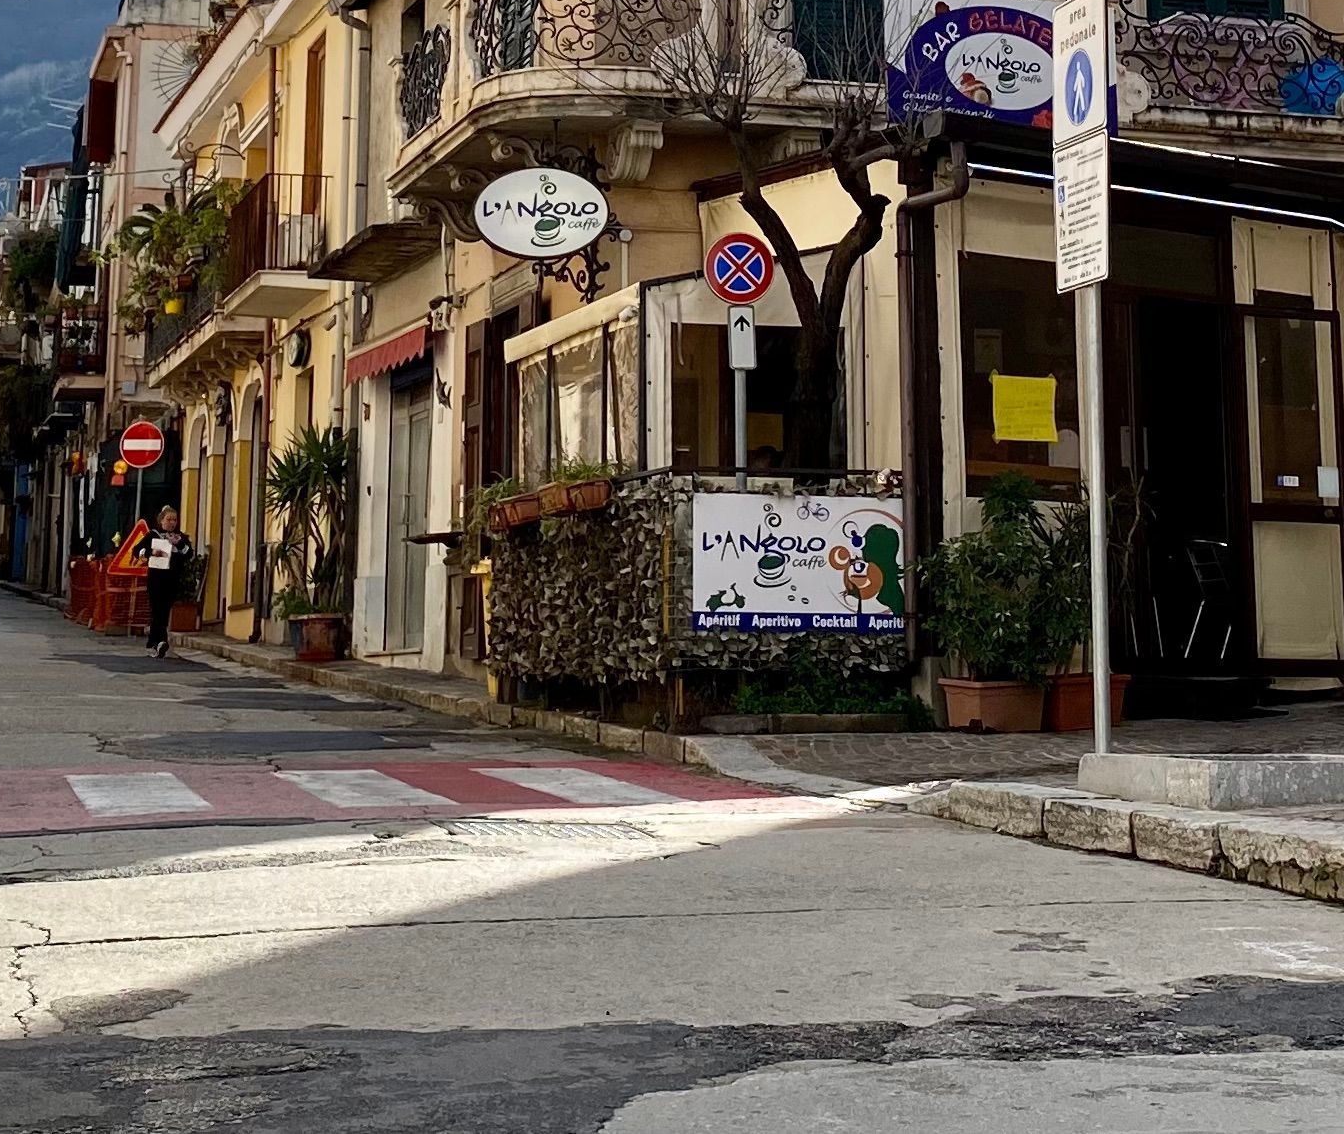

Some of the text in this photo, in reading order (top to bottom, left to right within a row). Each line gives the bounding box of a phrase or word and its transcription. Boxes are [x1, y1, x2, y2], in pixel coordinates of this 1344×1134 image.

[1069, 6, 1087, 24] area
[921, 22, 961, 62] BAR
[1060, 23, 1097, 55] pedonale
[568, 217, 602, 231] caffè
[792, 555, 827, 569] caffè
[752, 614, 802, 630] Aperitivo
[812, 614, 858, 629] Cocktail
